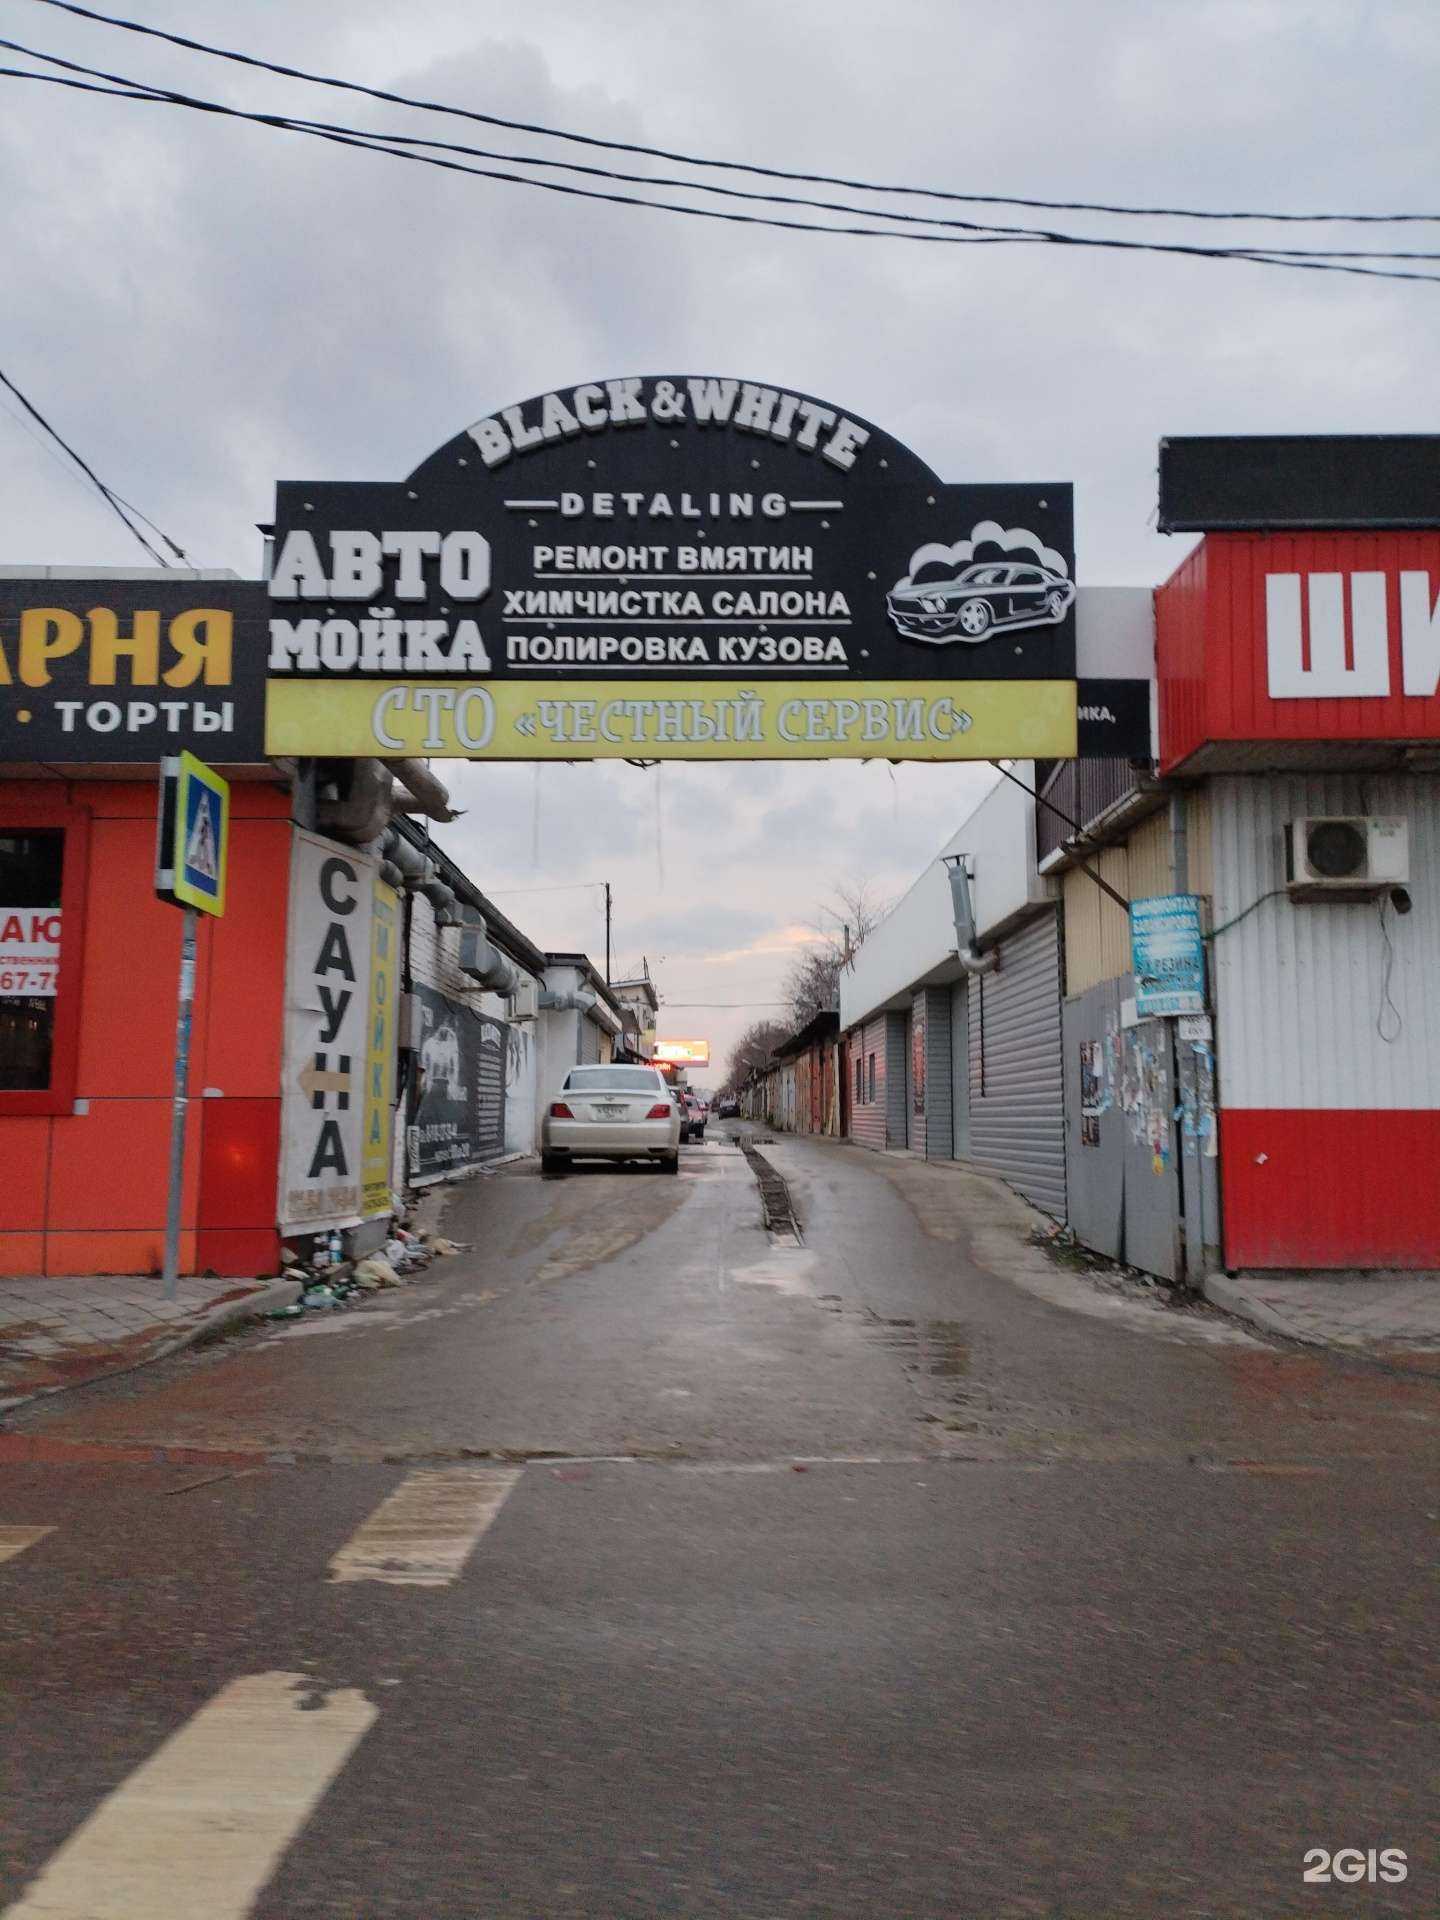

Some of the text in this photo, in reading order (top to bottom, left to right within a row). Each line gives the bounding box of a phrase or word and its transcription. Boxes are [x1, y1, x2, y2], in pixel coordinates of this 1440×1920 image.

[560, 493, 787, 517] DETALING
[268, 530, 491, 601] АВТО
[534, 546, 813, 571] РЕМОНТ ВМЯТИН
[502, 590, 851, 616] ХИМЧИСТКА САЛОНА
[0, 607, 234, 688] РНЯ
[268, 606, 492, 672] МОЙКА
[506, 636, 848, 662] ПОЛИРОВКА КУЗОВА
[54, 701, 235, 733] ТОРТЫ
[371, 686, 973, 751] СТО «ЧЕСТНЫЙ СЕРВИС»
[0, 972, 57, 991] 67-7
[307, 857, 358, 1179] САУНА
